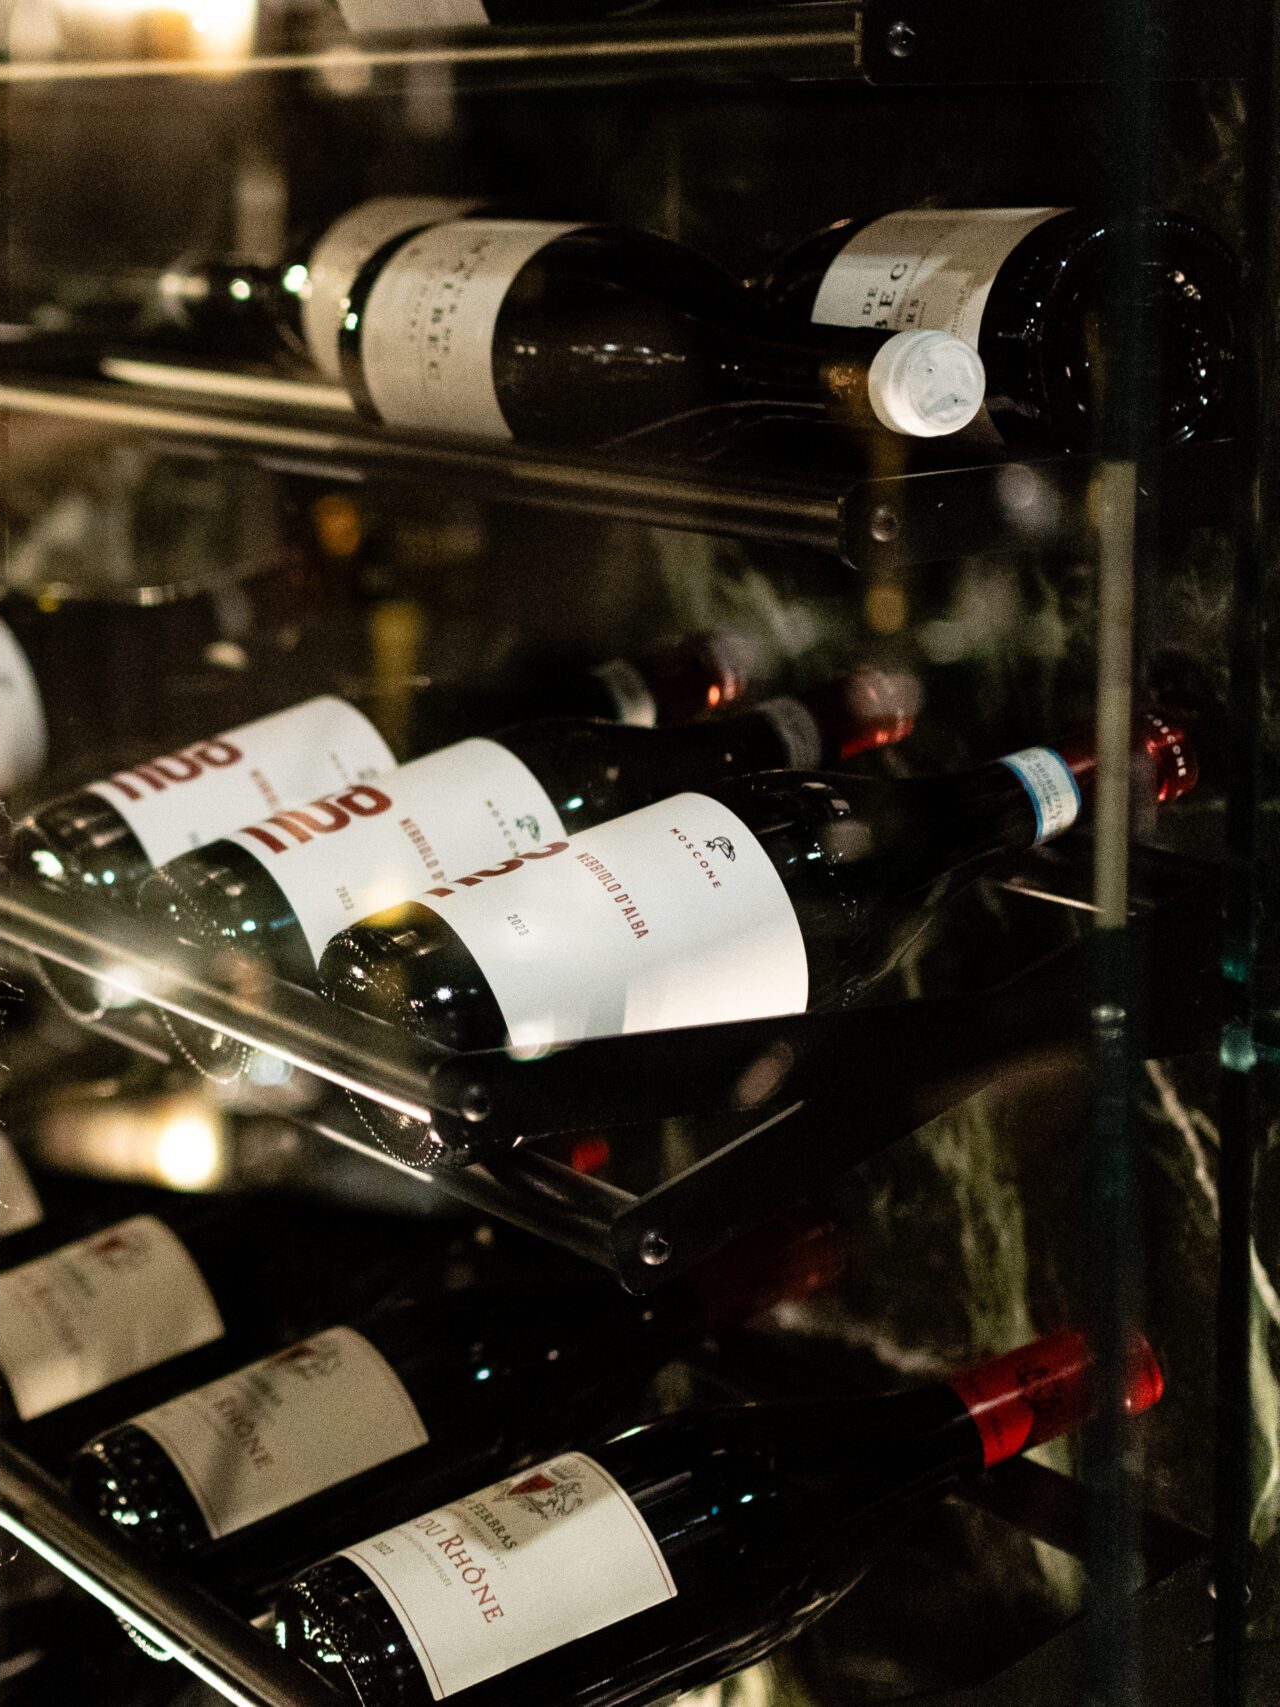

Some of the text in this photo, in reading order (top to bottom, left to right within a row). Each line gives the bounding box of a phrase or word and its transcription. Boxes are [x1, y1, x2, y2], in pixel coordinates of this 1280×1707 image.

[862, 286, 879, 317] DE
[669, 826, 722, 890] MOSCONE
[574, 851, 649, 940] NEBBIOLO D'ALBA
[506, 913, 530, 938] 2023
[470, 1501, 518, 1551] FERBRAS
[415, 1517, 447, 1538] DU
[437, 1533, 505, 1624] RHÔNE
